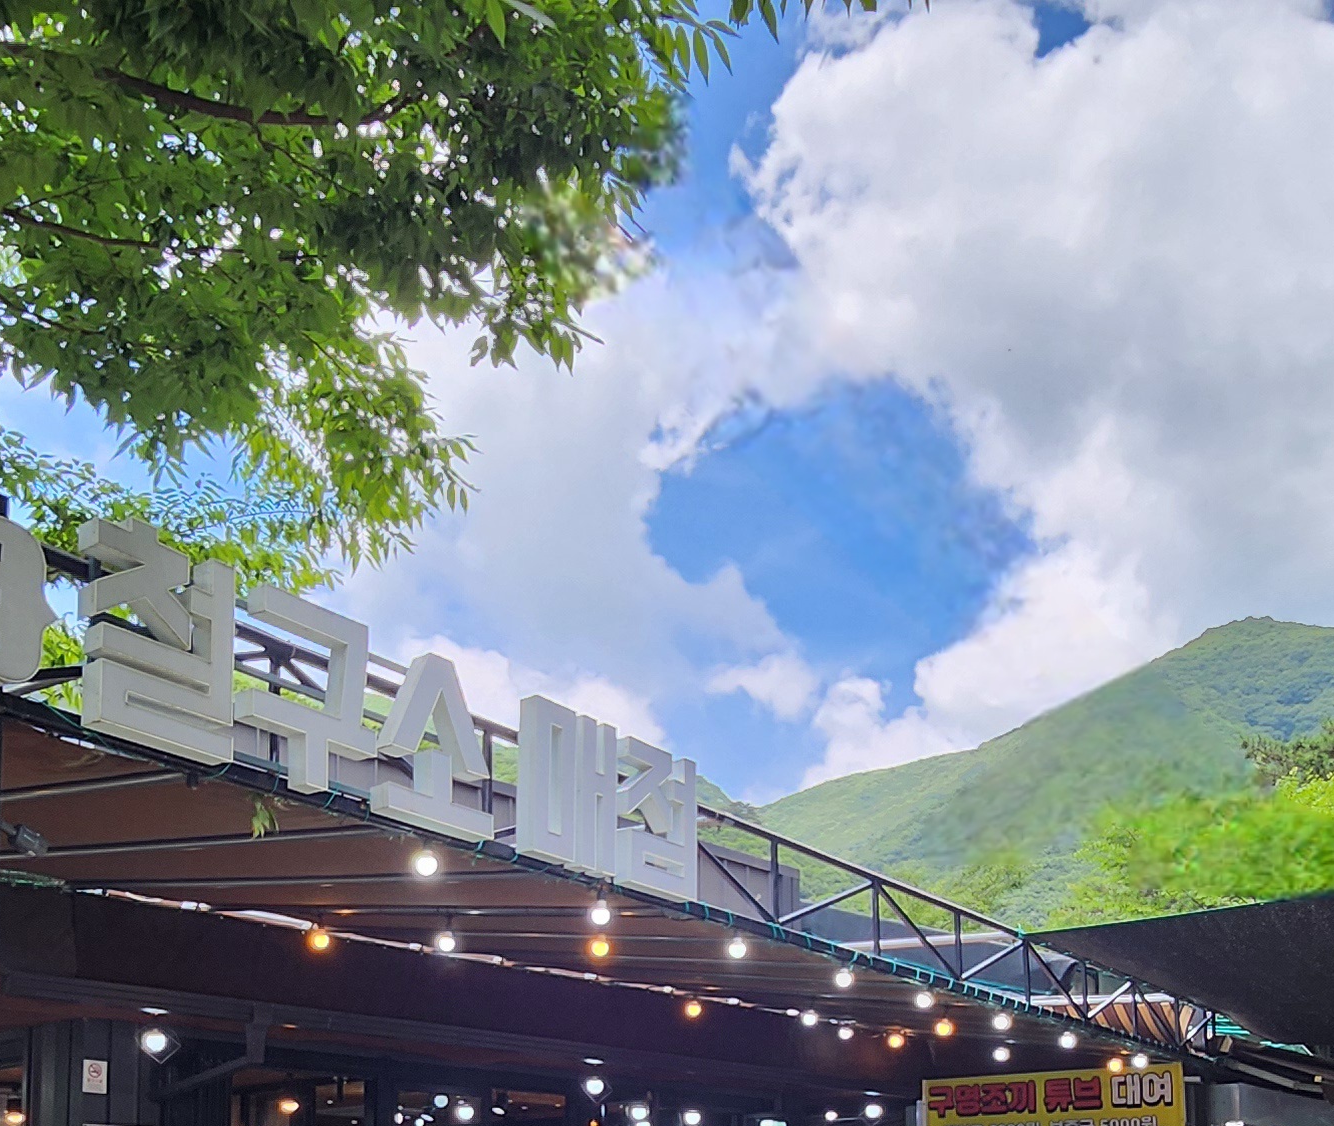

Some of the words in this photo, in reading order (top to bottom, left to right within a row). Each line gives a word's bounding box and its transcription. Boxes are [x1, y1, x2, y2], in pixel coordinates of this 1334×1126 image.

[78, 517, 495, 842] 철구소
[515, 694, 698, 904] 매점
[928, 1079, 1037, 1118] 구명조끼
[1044, 1076, 1103, 1112] 튜브
[1110, 1071, 1173, 1108] 대여
